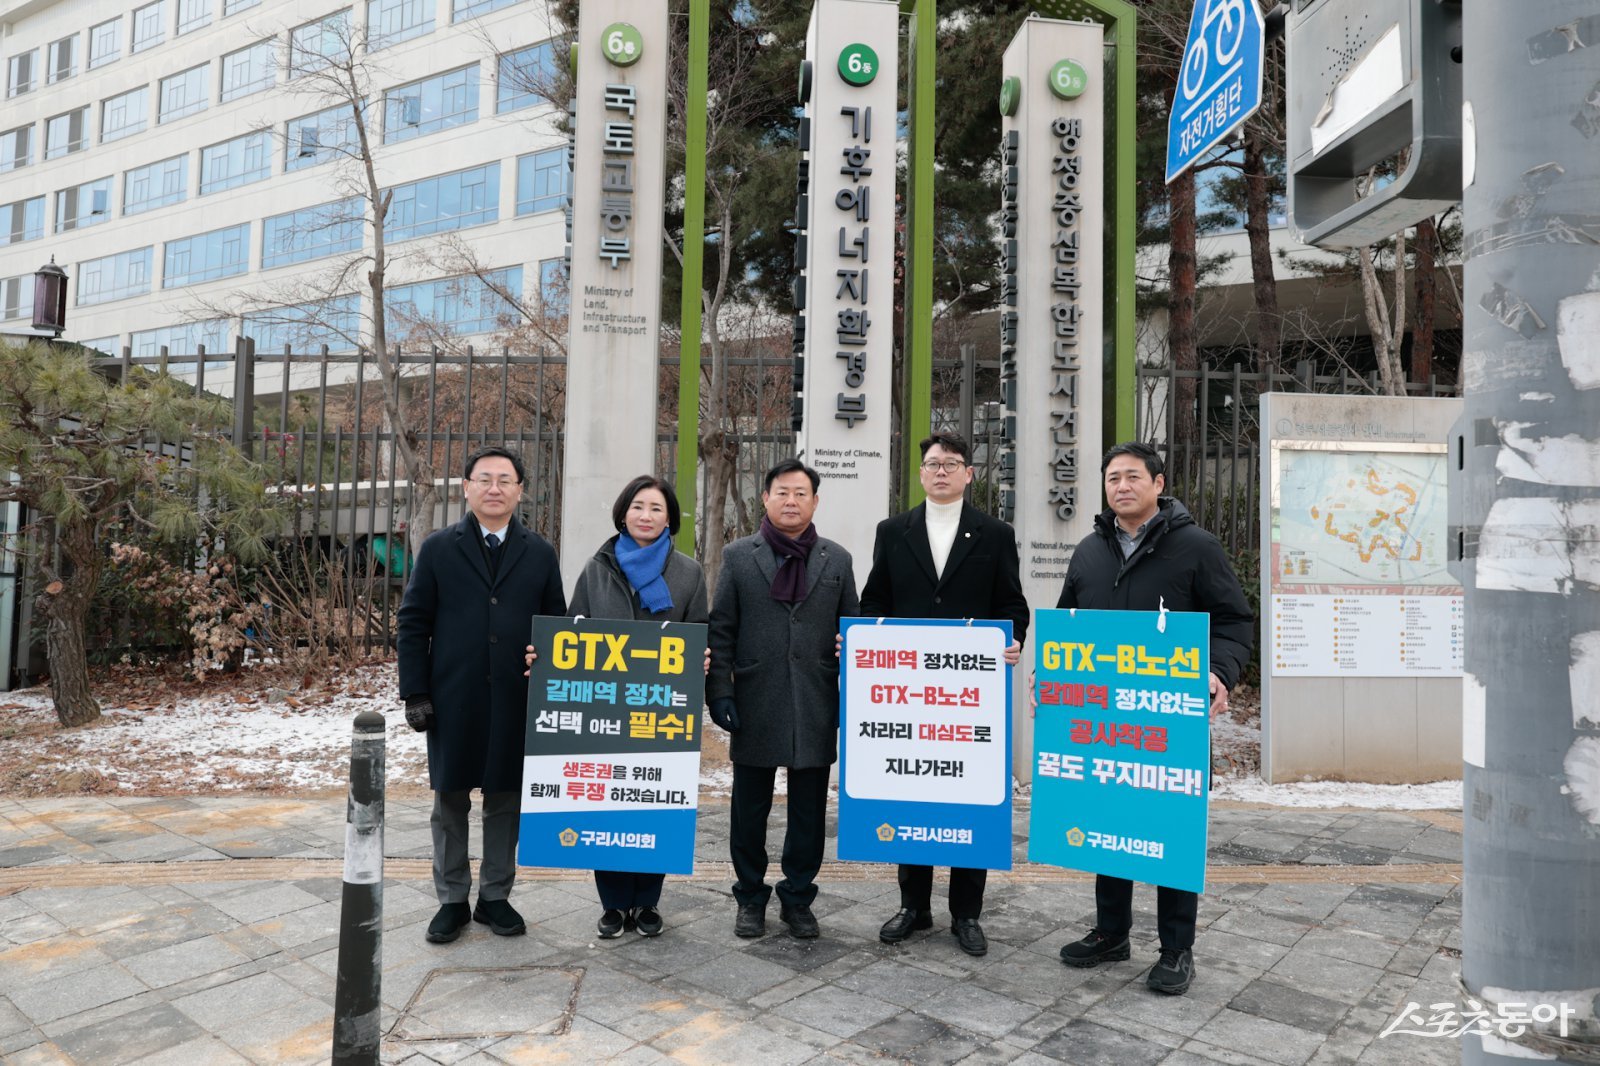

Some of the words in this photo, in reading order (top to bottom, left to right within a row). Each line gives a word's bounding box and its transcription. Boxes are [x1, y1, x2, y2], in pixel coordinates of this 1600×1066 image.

[1179, 75, 1242, 157] 자전거횡단
[599, 83, 637, 270] 국토교통부
[835, 106, 872, 429] 기후에너지환경부
[584, 285, 622, 298] Ministry
[624, 287, 634, 297] of
[583, 298, 608, 310] Land,
[583, 311, 647, 324] Infrastructure
[1049, 117, 1083, 521] 행정중심복합도시건설청
[583, 324, 600, 333] and
[602, 323, 647, 336] Transport
[814, 459, 839, 469] Energy
[815, 448, 843, 458] Ministry
[844, 449, 852, 457] of
[853, 449, 882, 459] Climate,
[816, 471, 858, 479] nvironment
[1059, 542, 1077, 552] Agen
[552, 630, 685, 675] GTX-B
[854, 649, 918, 670] 갈매역
[923, 652, 997, 672] 정차없는
[1042, 641, 1201, 679] GTX-B노선
[546, 679, 617, 705] 갈매역
[624, 682, 688, 708] 정차는
[870, 684, 980, 708] GTX-B노선
[1039, 681, 1109, 710] 갈매역
[1115, 687, 1205, 717] 정차없는
[535, 710, 583, 735] 선택
[589, 718, 621, 736] 아닌
[629, 711, 695, 741] 필수!
[859, 721, 912, 740] 차라리
[918, 723, 992, 743] 대심도로
[1069, 719, 1168, 752] 공사착공
[562, 761, 627, 780] 생존권을
[632, 766, 662, 782] 위해
[885, 758, 964, 778] 지나가라!
[1038, 751, 1084, 781] 꿈도
[1091, 757, 1202, 796] 꾸지마라!
[530, 783, 560, 799] 함께
[566, 781, 606, 801] 투쟁
[610, 787, 690, 805] 하겠습니다.
[580, 830, 656, 850] 구리시의회
[897, 825, 973, 845] 구리시의회
[1087, 831, 1164, 859] 구리시의회
